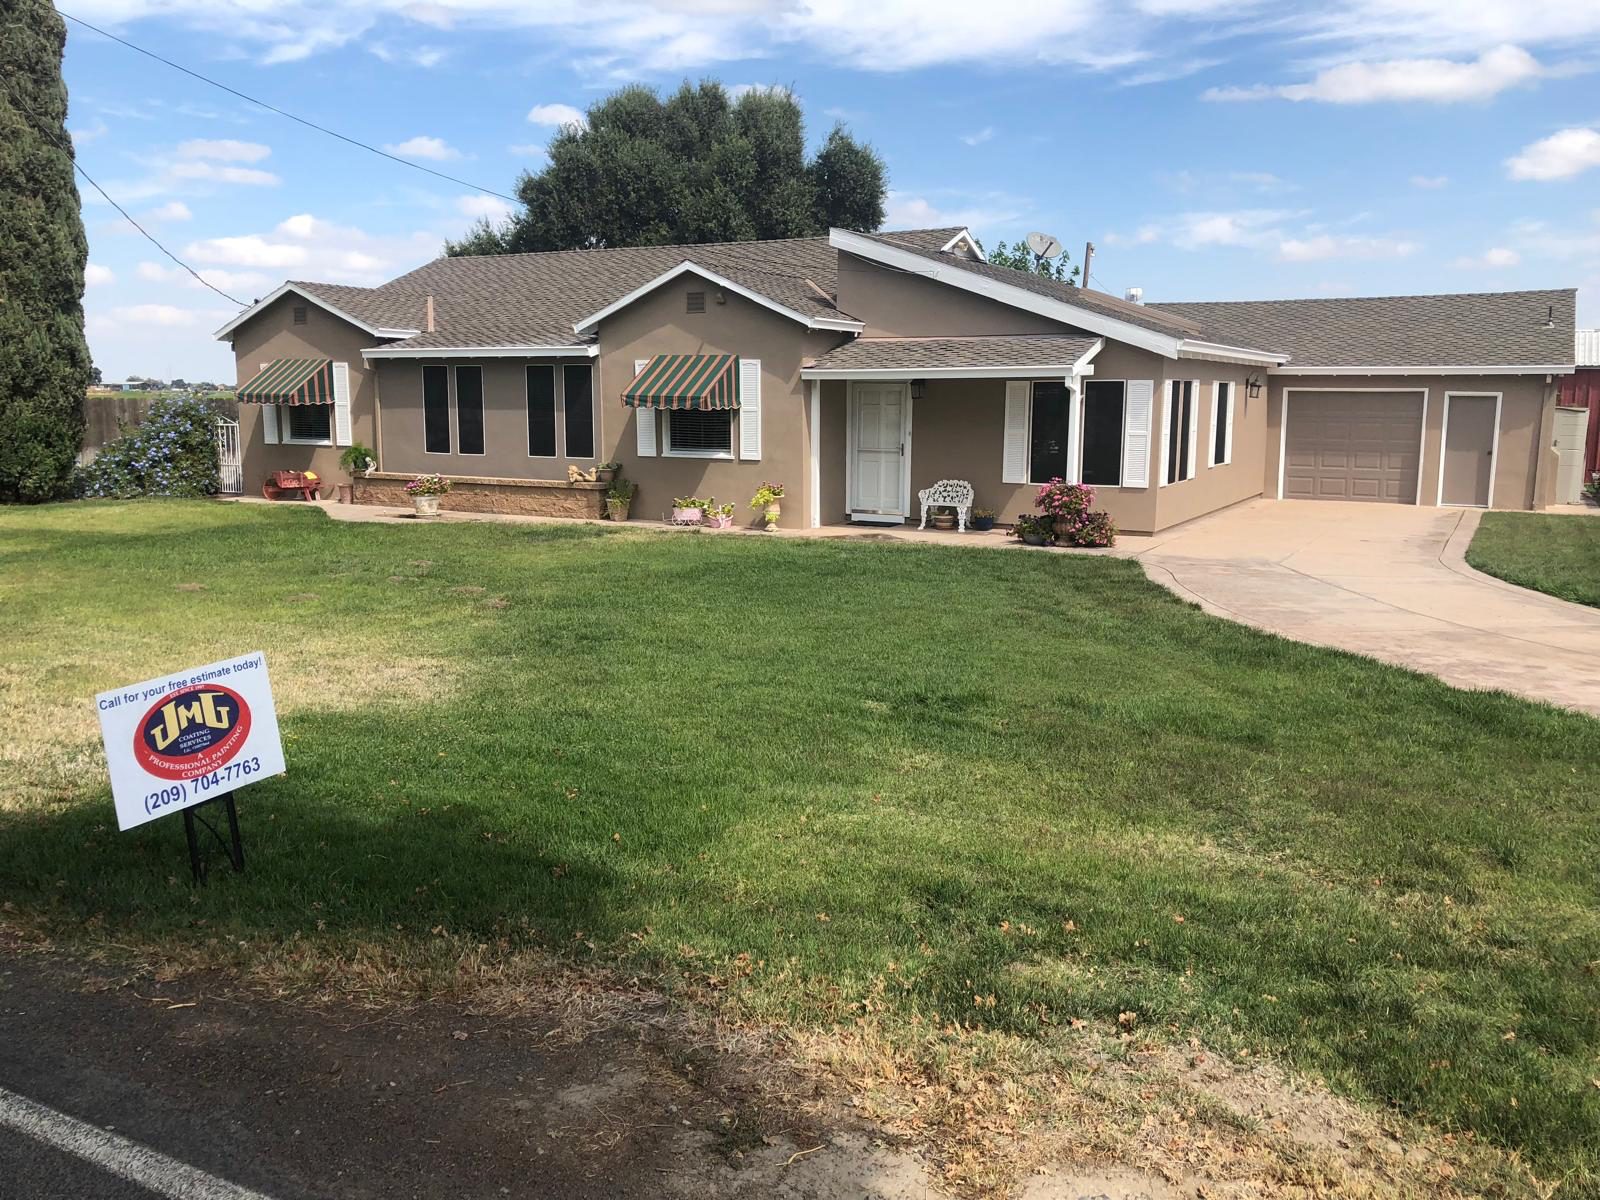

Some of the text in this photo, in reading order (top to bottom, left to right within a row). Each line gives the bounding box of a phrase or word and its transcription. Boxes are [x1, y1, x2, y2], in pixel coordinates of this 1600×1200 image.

[99, 657, 262, 710] Call for your free estimate today!
[150, 692, 230, 751] JMG
[178, 728, 210, 742] COATING
[179, 734, 212, 749] SERVICES
[148, 725, 243, 770] PROFESSIONAL PAINTING
[181, 759, 223, 778] COMPANY
[144, 757, 261, 815] (209) 704-7763
